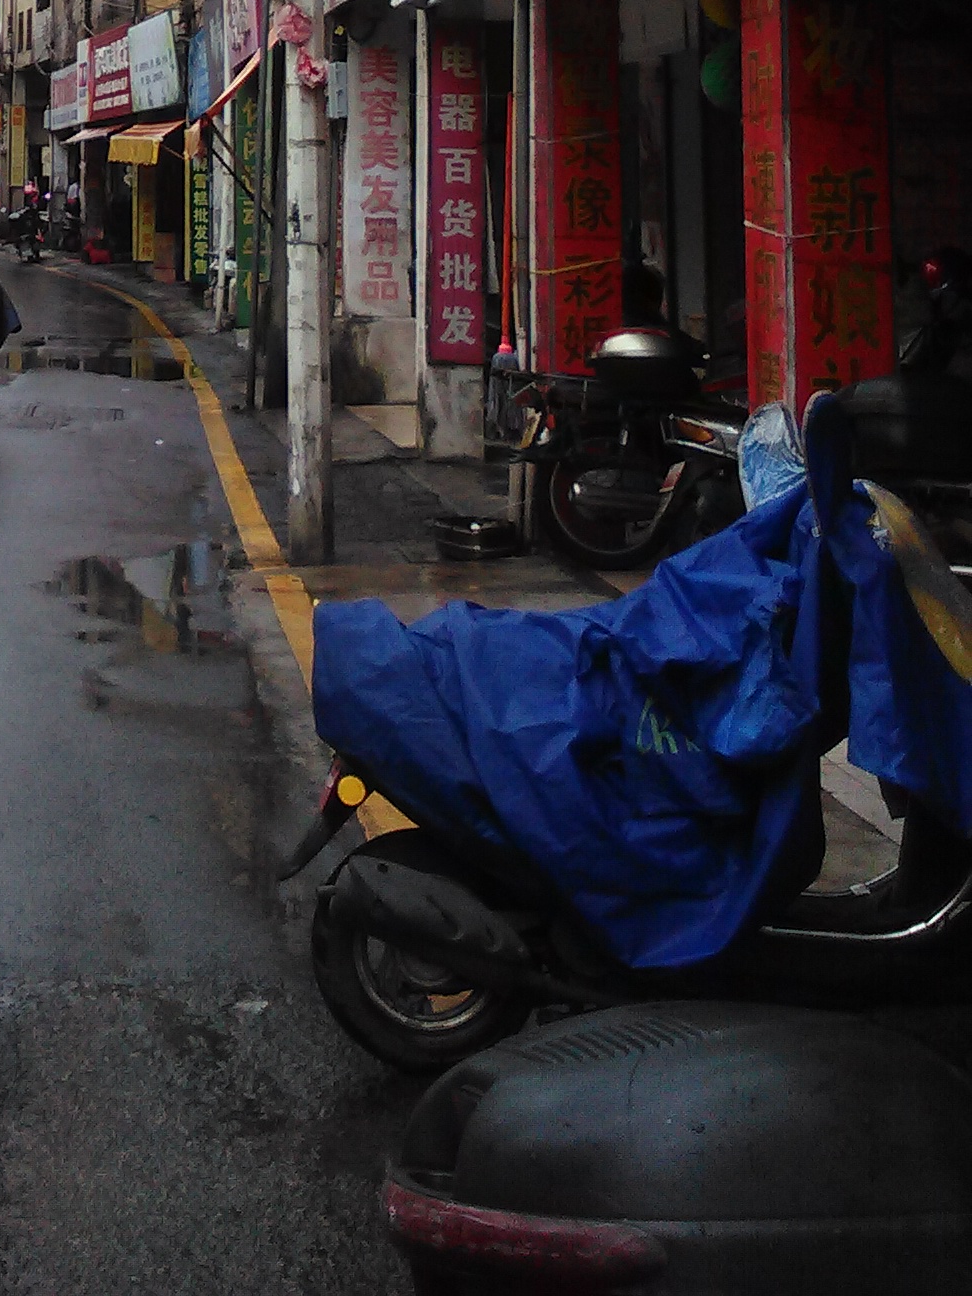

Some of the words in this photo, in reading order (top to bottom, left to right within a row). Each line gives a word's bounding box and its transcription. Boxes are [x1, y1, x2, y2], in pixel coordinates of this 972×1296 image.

[359, 43, 400, 302] 美容美发用品
[438, 45, 478, 345] 电器百货批发
